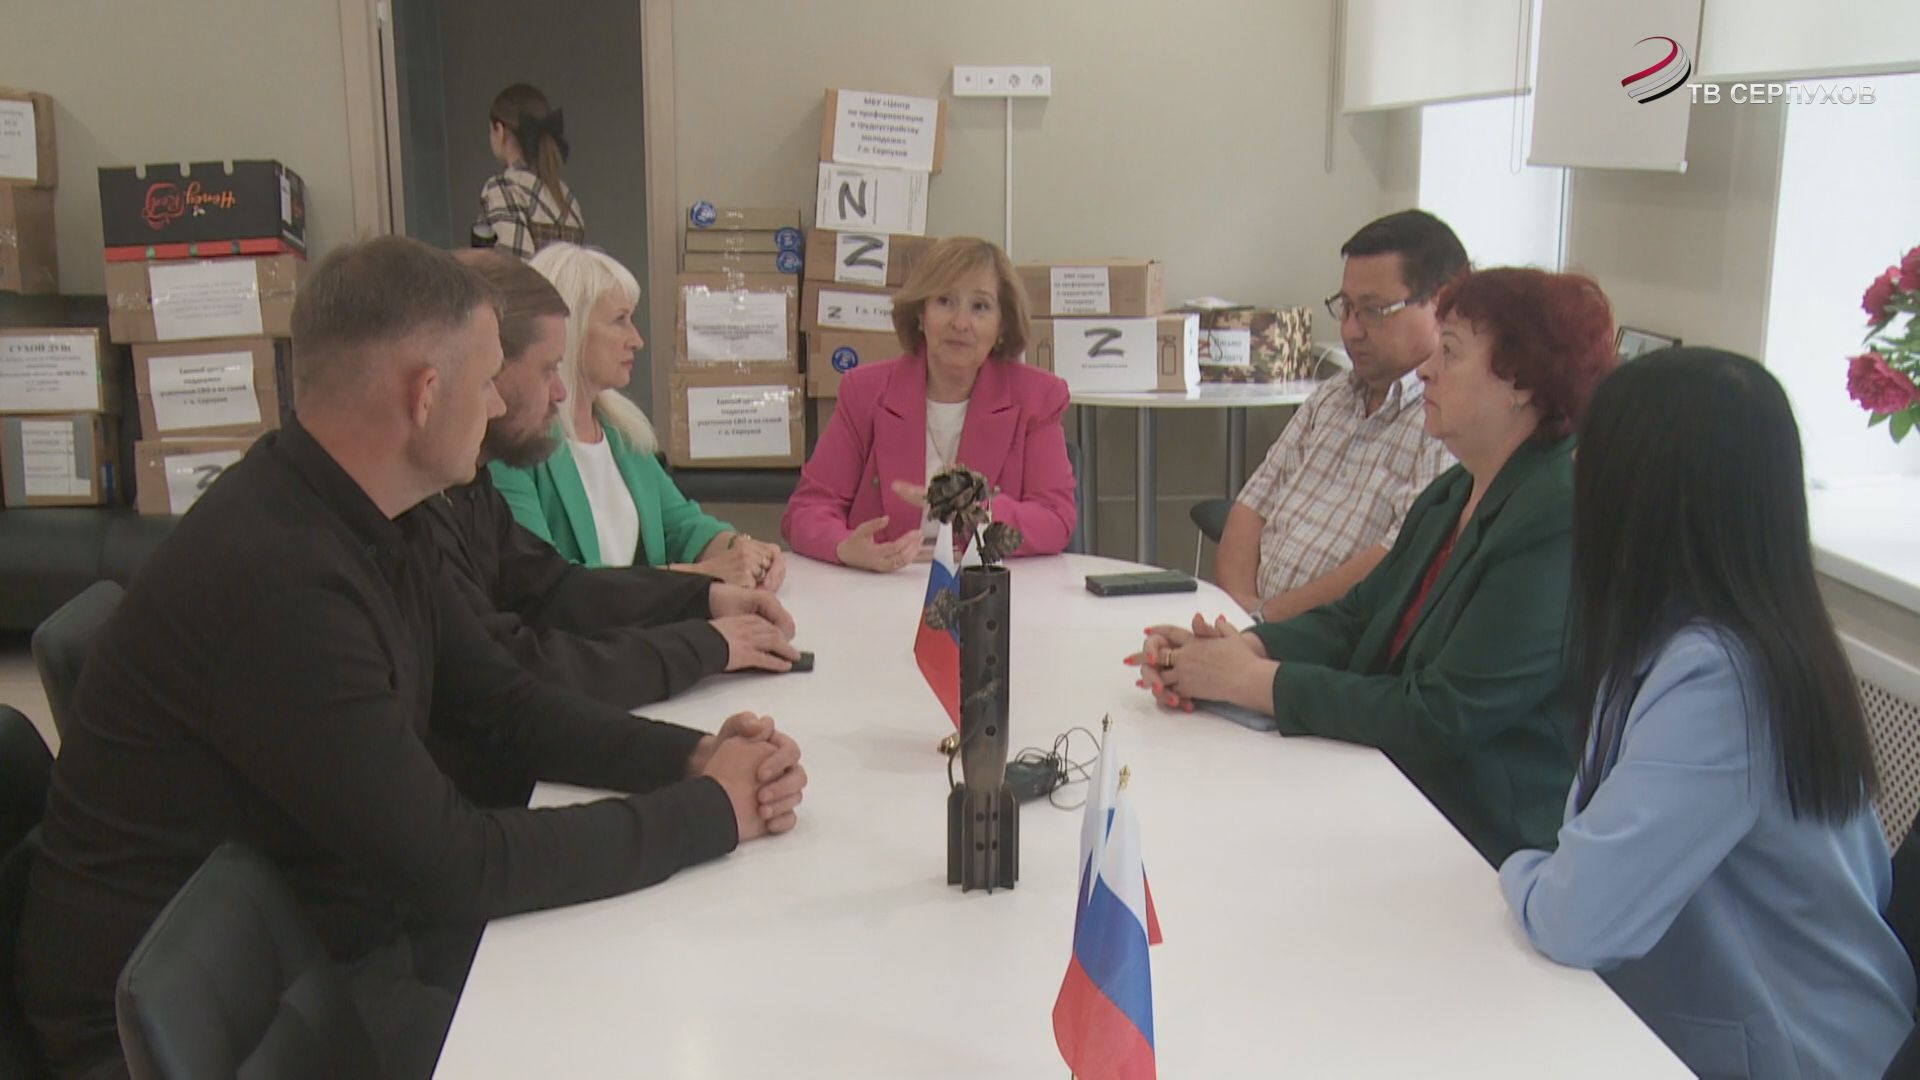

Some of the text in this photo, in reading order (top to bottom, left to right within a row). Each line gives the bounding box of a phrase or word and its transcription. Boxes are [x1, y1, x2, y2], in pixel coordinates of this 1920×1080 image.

[873, 146, 908, 158] Серпухов
[186, 181, 235, 208] Honey
[842, 235, 886, 270] Z
[827, 306, 843, 320] Z
[9, 344, 46, 353] СУХОЙ
[1084, 328, 1125, 358] Z
